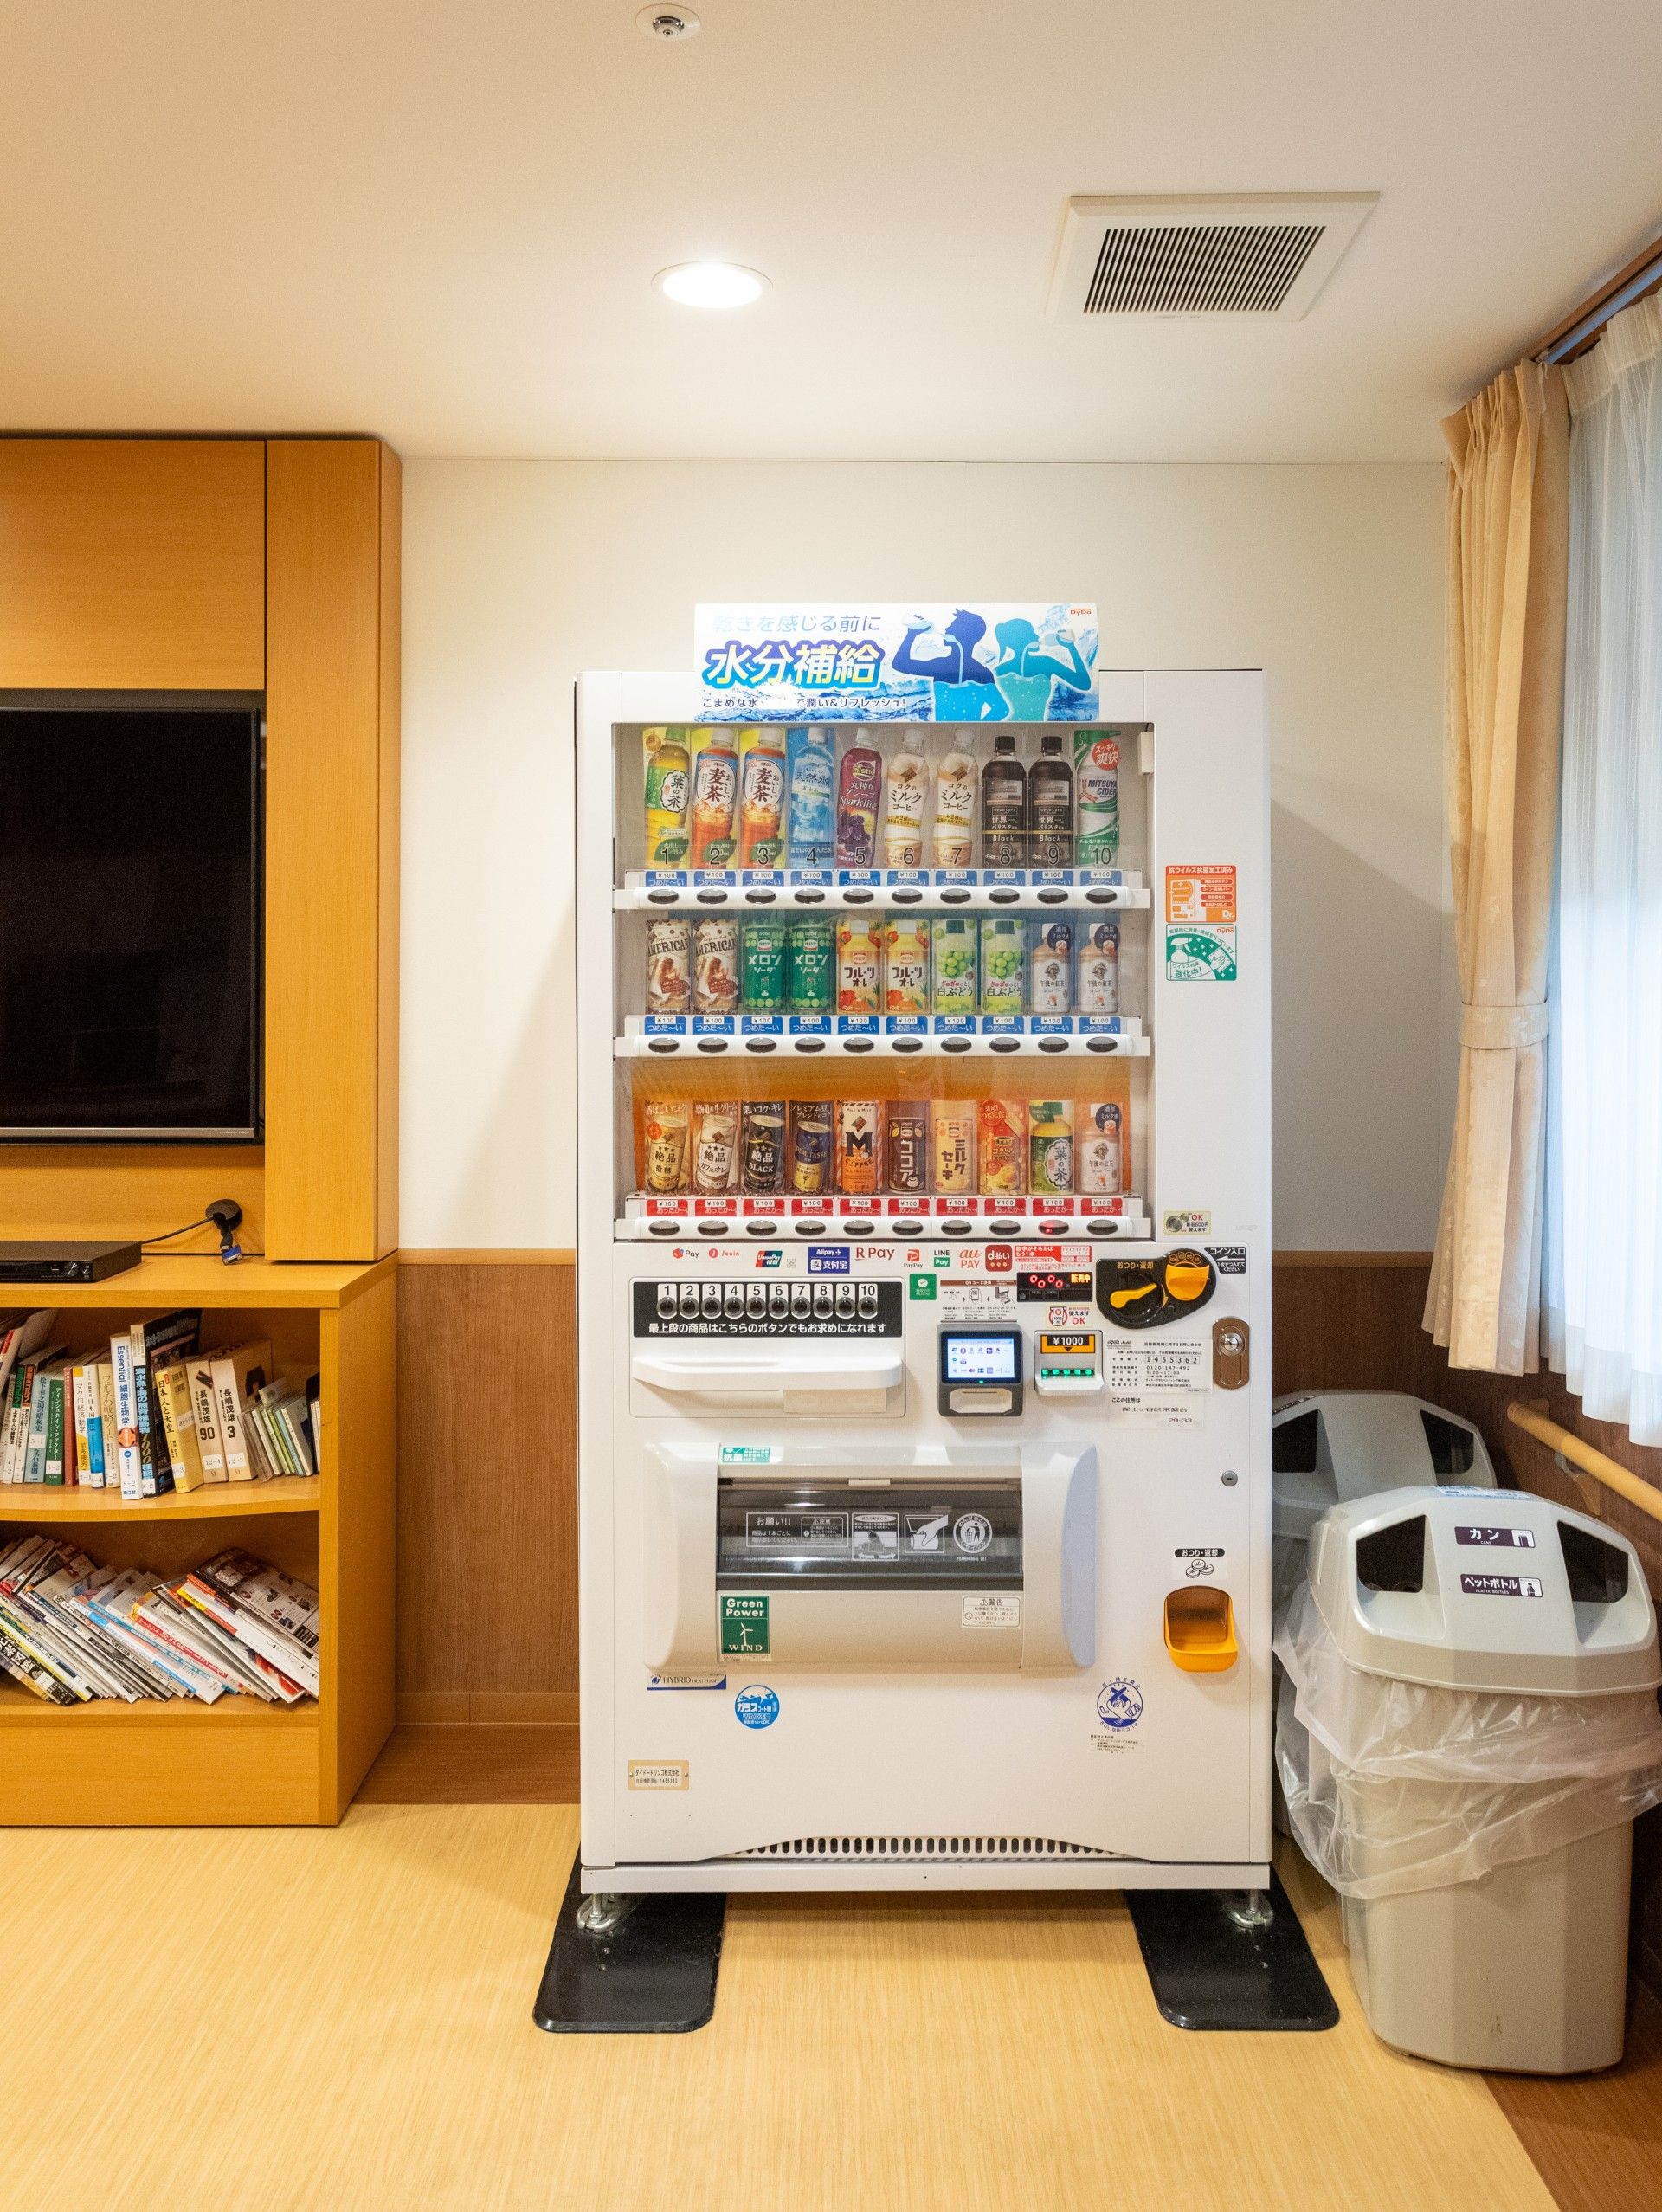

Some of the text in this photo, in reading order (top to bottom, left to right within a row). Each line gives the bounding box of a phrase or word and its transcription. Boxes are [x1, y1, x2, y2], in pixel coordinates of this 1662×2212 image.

[705, 642, 883, 687] 水分補給
[703, 698, 906, 708] こまめな水で潤い&リフレッシュ!
[795, 771, 830, 785] 天然水
[705, 768, 725, 803] 麦茶
[753, 768, 773, 803] 麦茶
[667, 775, 685, 809] 葉の茶
[891, 791, 922, 803] ミルク
[941, 791, 972, 803] ミルク
[892, 803, 918, 812] コーヒー
[944, 803, 968, 811] コーヒー
[661, 849, 669, 865] 1
[710, 848, 720, 865] 2
[758, 848, 769, 865] 3
[807, 848, 818, 864] 4
[855, 848, 866, 864] 5
[903, 848, 914, 864] 6
[951, 848, 962, 864] 7
[1001, 848, 1011, 865] 8
[1048, 848, 1059, 865] 9
[1093, 848, 1111, 865] 10
[748, 954, 782, 965] メロン
[795, 954, 828, 965] メロン
[844, 967, 875, 979] フルーツ
[892, 967, 923, 979] フルーツ
[937, 988, 973, 996] 白ぶどう
[987, 988, 1021, 996] 白ぶどう
[845, 1132, 873, 1157] M
[655, 1151, 676, 1163] 絶品
[705, 1151, 725, 1163] 絶品
[751, 1151, 773, 1163] 絶品
[900, 1139, 914, 1182] ココア
[955, 1139, 967, 1175] ミルク
[749, 1163, 774, 1172] BLACK
[941, 1151, 953, 1181] セーキ
[1054, 1147, 1067, 1182] 葉の茶
[855, 1247, 895, 1261] R Pay
[959, 1249, 982, 1258] au
[987, 1252, 1010, 1261] d払い
[823, 1261, 847, 1269] 支付宝
[961, 1260, 980, 1268] PAY
[664, 1285, 670, 1296] 1
[686, 1285, 693, 1296] 2
[708, 1285, 716, 1296] 3
[730, 1285, 738, 1296] 4
[752, 1285, 760, 1296] 5
[775, 1285, 783, 1296] 6
[797, 1285, 805, 1296] 7
[820, 1285, 828, 1296] 8
[842, 1285, 849, 1296] 9
[861, 1285, 875, 1296] 10
[648, 1323, 887, 1333] 最上段の商品はこちらのボタンでもお求めになれます
[117, 1346, 126, 1385] Essential
[158, 1380, 174, 1434] 日本人と天皇
[199, 1390, 211, 1423] 長嶋茂雄
[223, 1389, 235, 1422] 長嶋茂雄
[199, 1427, 216, 1441] 90
[228, 1426, 235, 1438] 3
[1470, 1528, 1499, 1540] カン
[1464, 1577, 1518, 1590] ペットボトル
[726, 1599, 763, 1608] Green
[725, 1608, 764, 1617] Power
